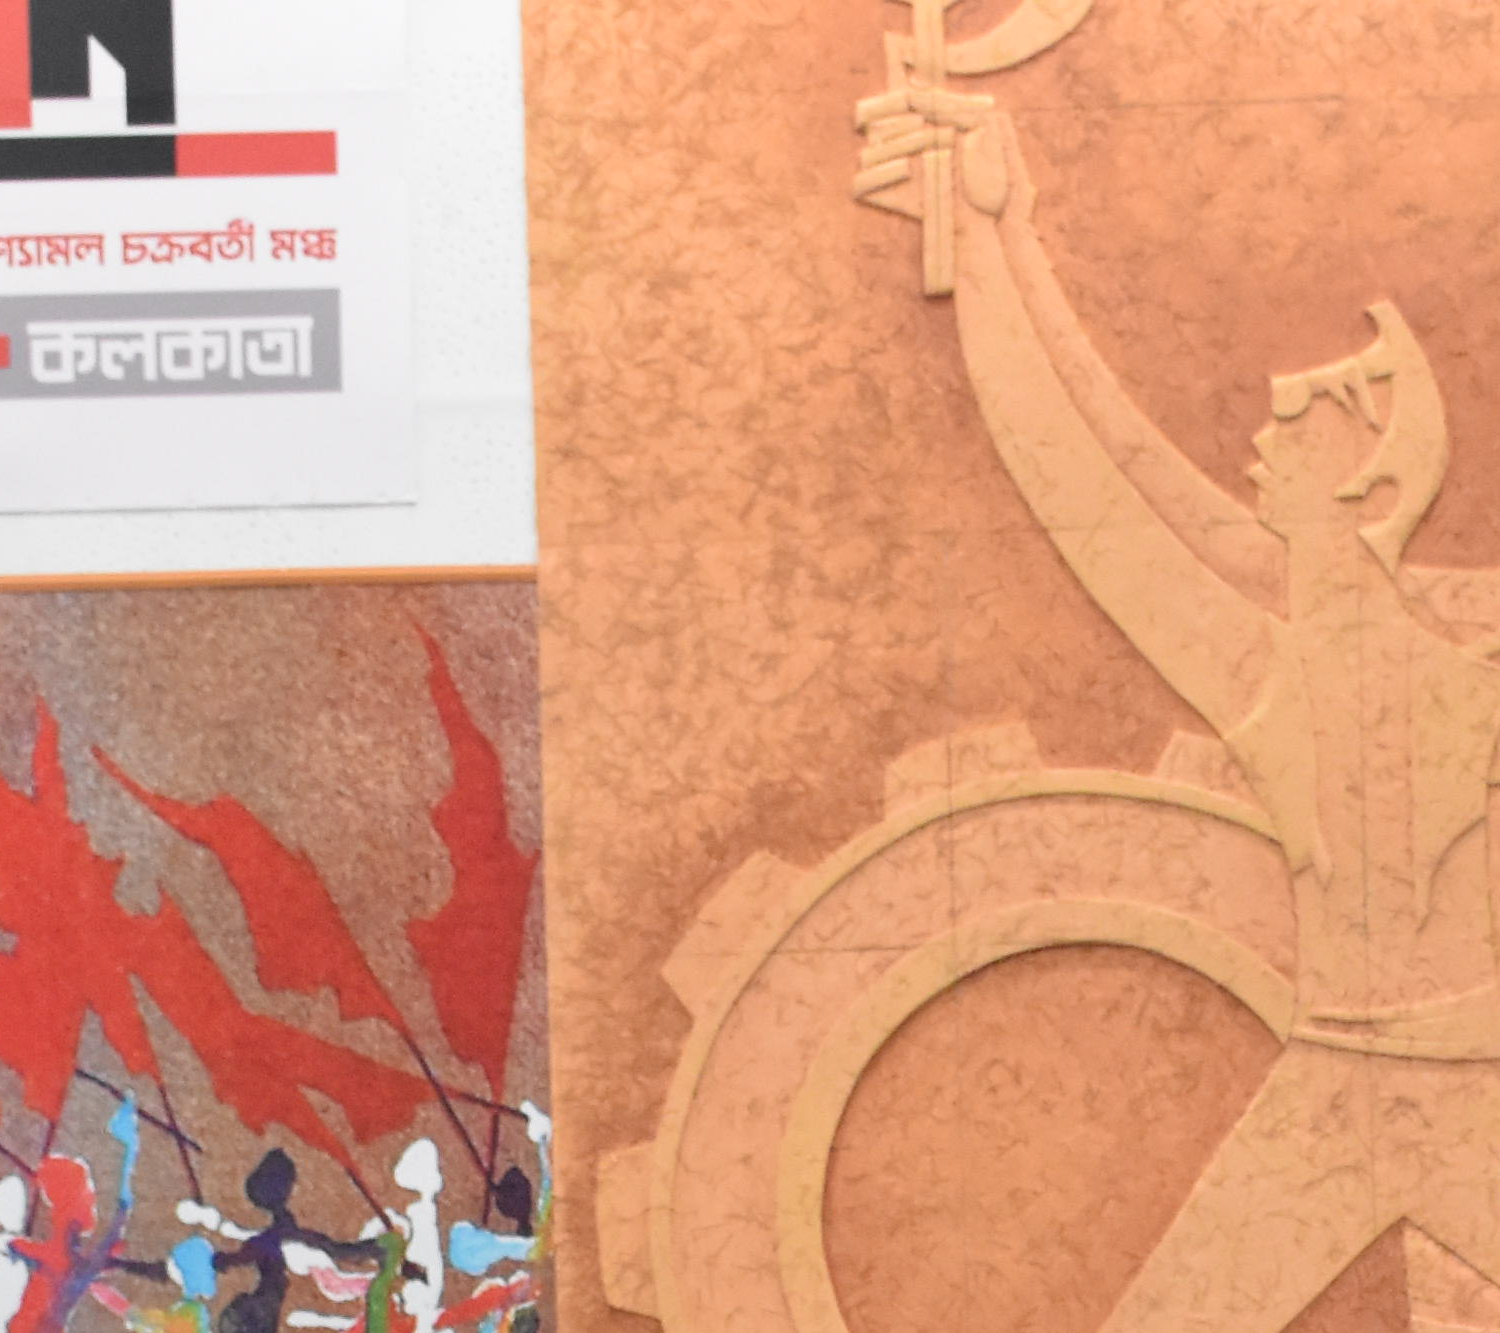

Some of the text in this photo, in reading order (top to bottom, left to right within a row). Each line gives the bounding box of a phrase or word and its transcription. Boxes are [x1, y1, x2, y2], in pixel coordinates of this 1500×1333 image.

[120, 218, 256, 266] চক্রবর্তী
[270, 228, 338, 261] মঞ্চ
[25, 315, 315, 385] কলকাতা
